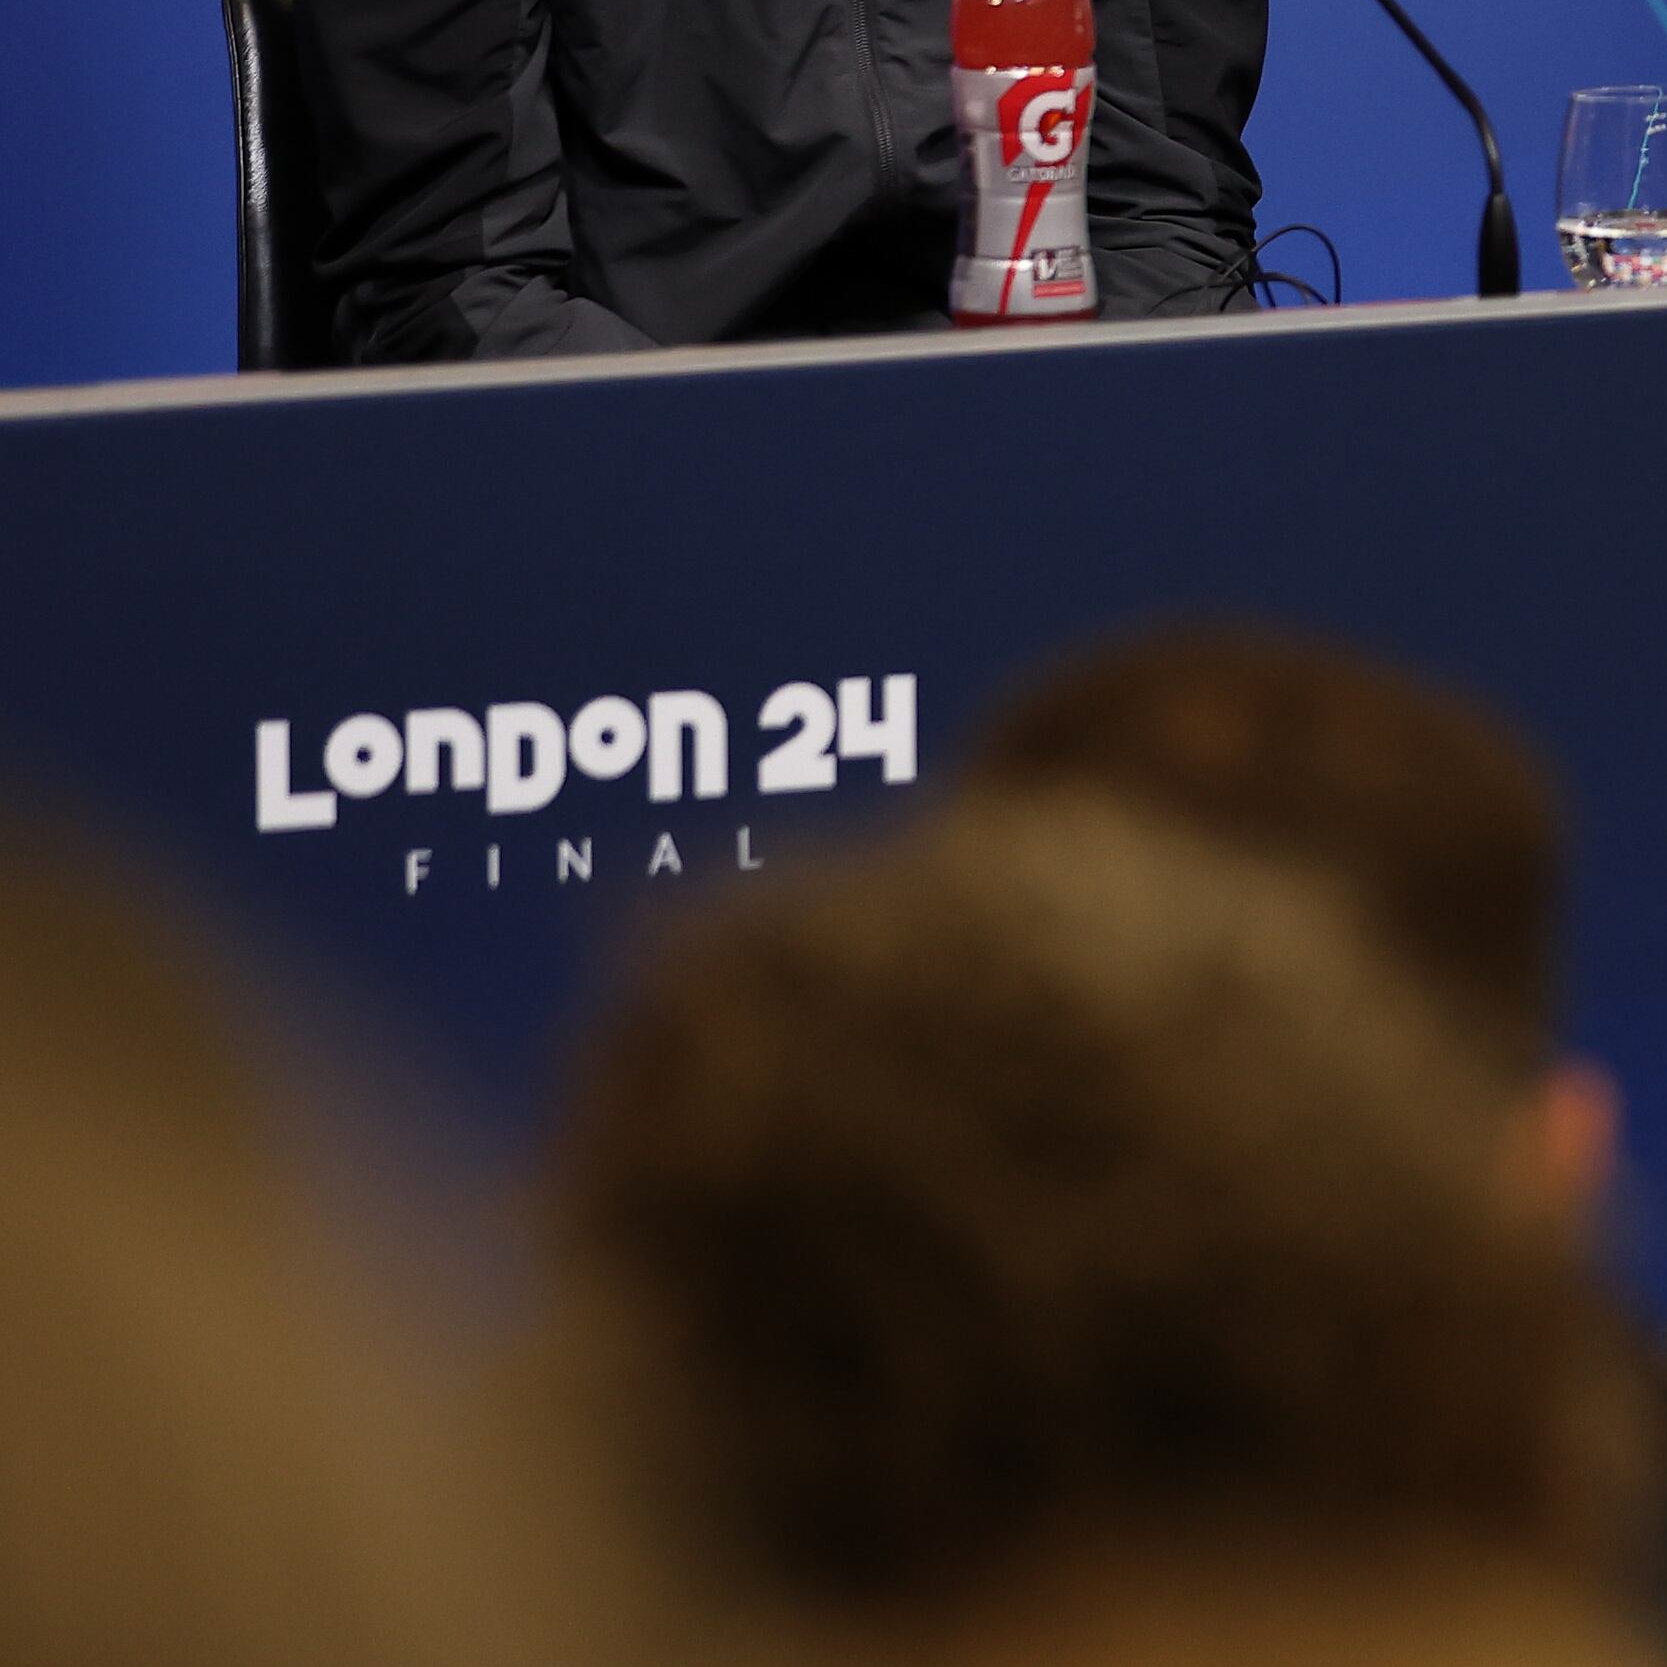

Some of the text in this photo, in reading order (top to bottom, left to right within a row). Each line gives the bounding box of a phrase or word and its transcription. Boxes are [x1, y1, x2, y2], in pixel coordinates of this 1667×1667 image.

[1019, 89, 1077, 163] G
[757, 674, 917, 796] 24
[406, 826, 763, 895] FINAL
